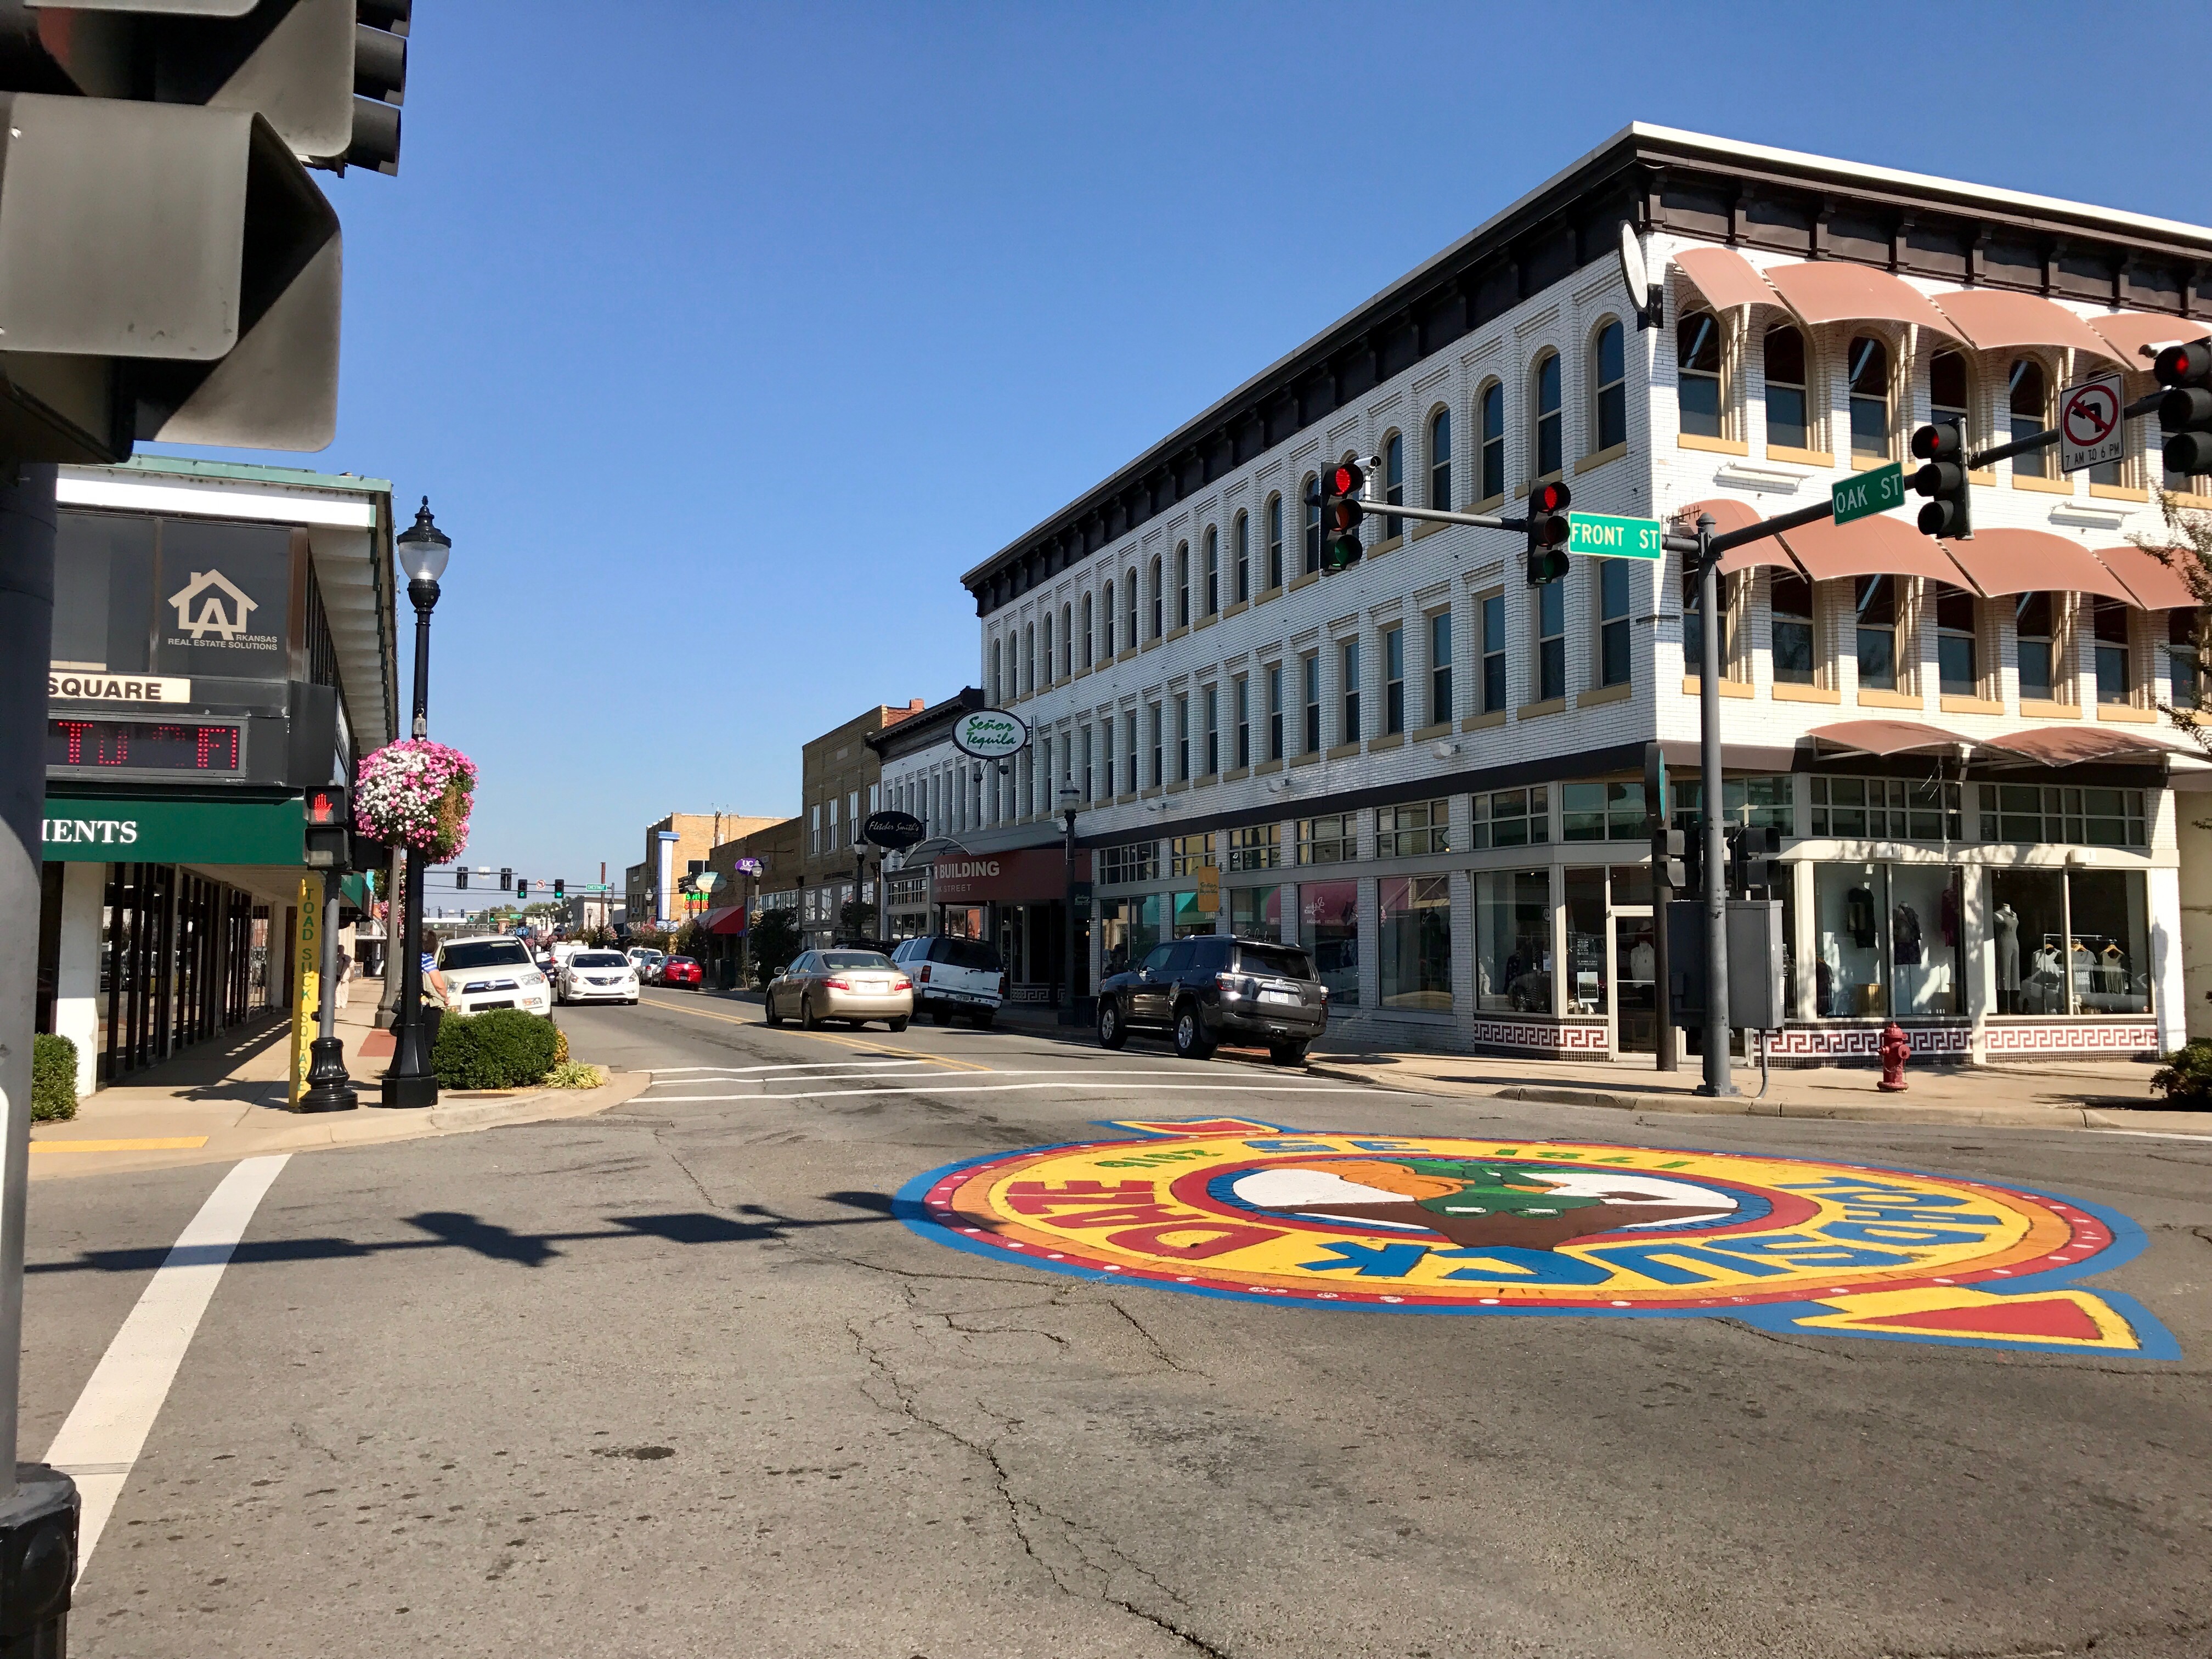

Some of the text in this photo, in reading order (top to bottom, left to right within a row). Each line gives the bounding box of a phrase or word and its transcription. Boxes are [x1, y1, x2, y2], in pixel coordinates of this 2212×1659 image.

[2065, 442, 2120, 467] 7 AM TO 6 PM
[1836, 473, 1900, 514] OAK ST
[1571, 523, 1658, 550] FRONT ST
[228, 642, 278, 650] SOLUTIONS
[48, 676, 162, 700] SQUARE
[967, 715, 1014, 731] Señor
[966, 732, 1016, 749] Tequila
[868, 821, 919, 831] Fletcher Smith's
[940, 861, 1000, 879] BUILDING
[944, 884, 972, 893] STREET
[298, 888, 315, 1092] TOAD SUCK SQUARE
[1094, 1149, 1224, 1168] 2016
[1006, 1176, 2003, 1285] TOAD SUCK DAZE
